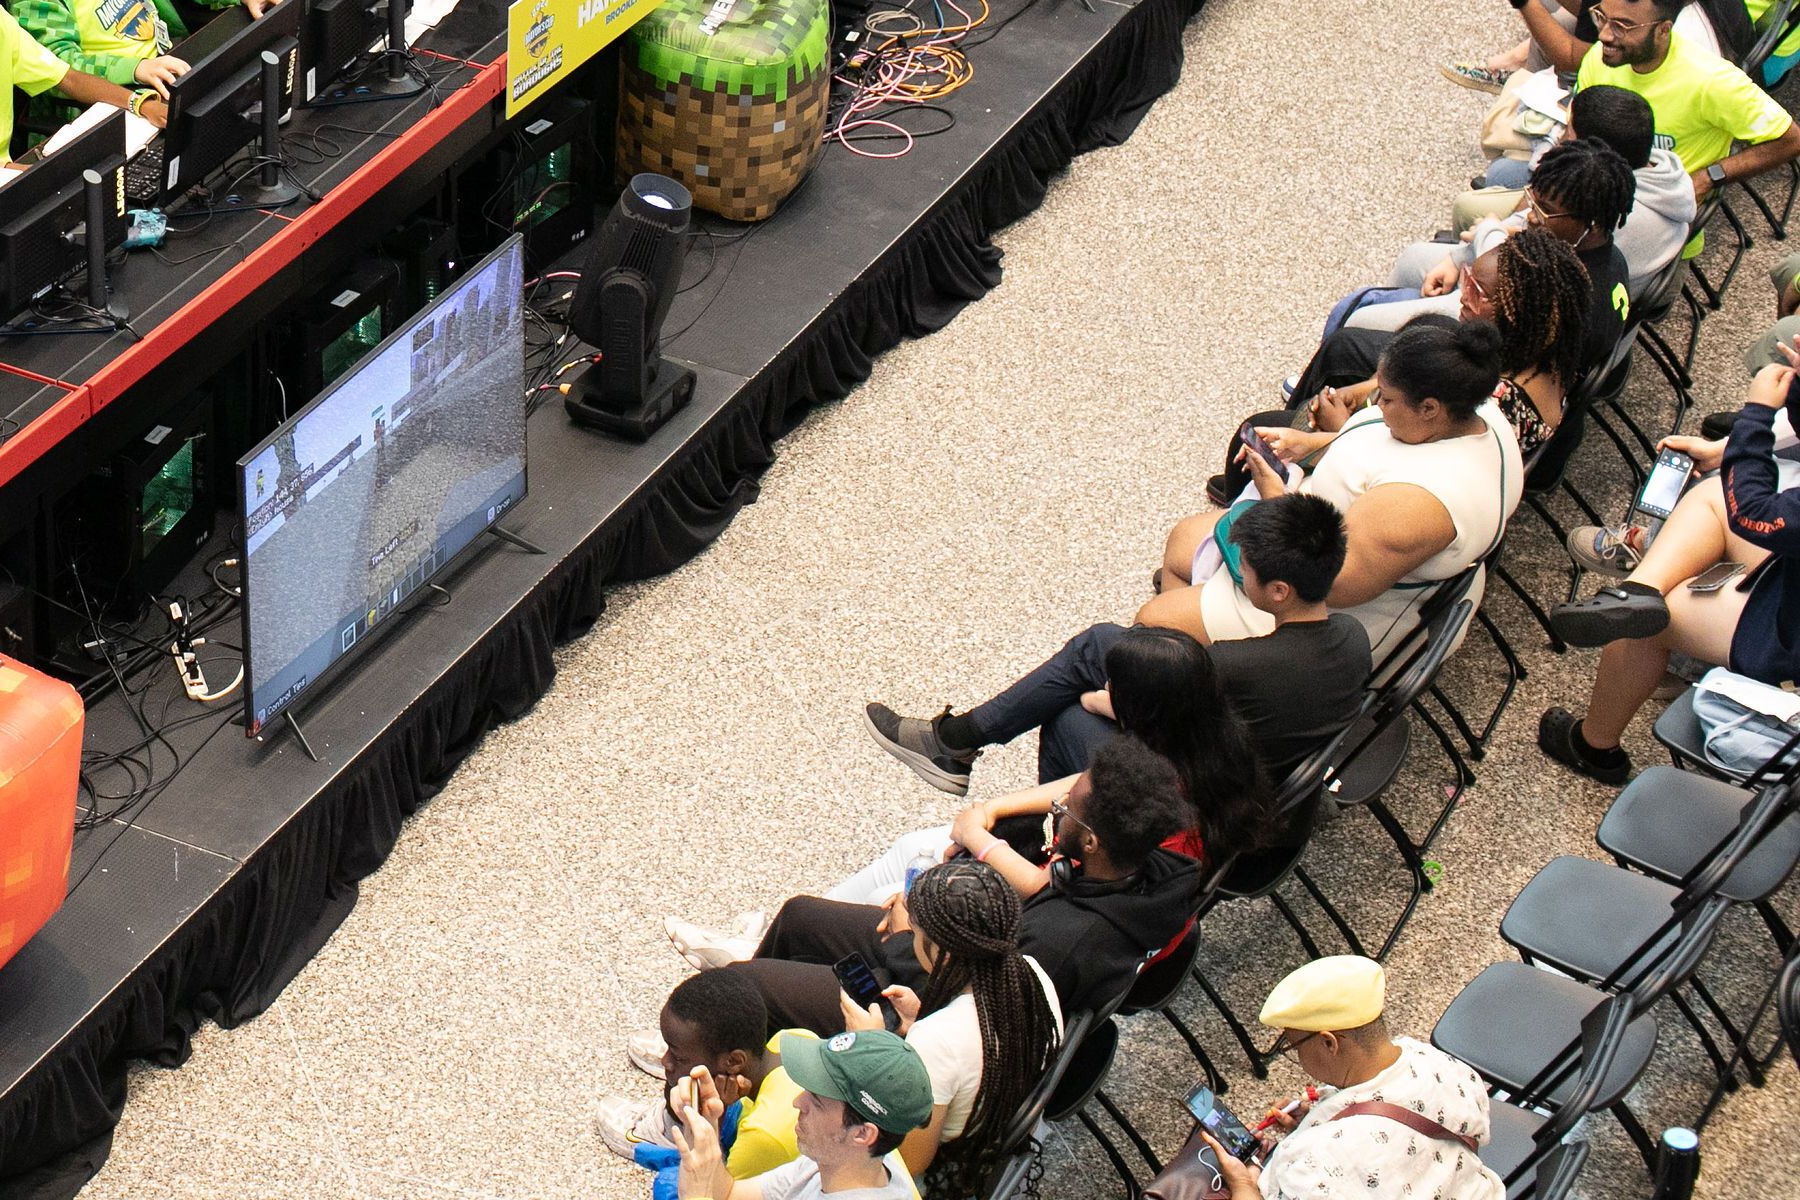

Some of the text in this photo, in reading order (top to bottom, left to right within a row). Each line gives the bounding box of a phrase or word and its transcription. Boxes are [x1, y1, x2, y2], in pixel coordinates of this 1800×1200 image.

[285, 47, 297, 95] LEGION
[116, 165, 125, 218] LEGION
[267, 689, 291, 715] Control
